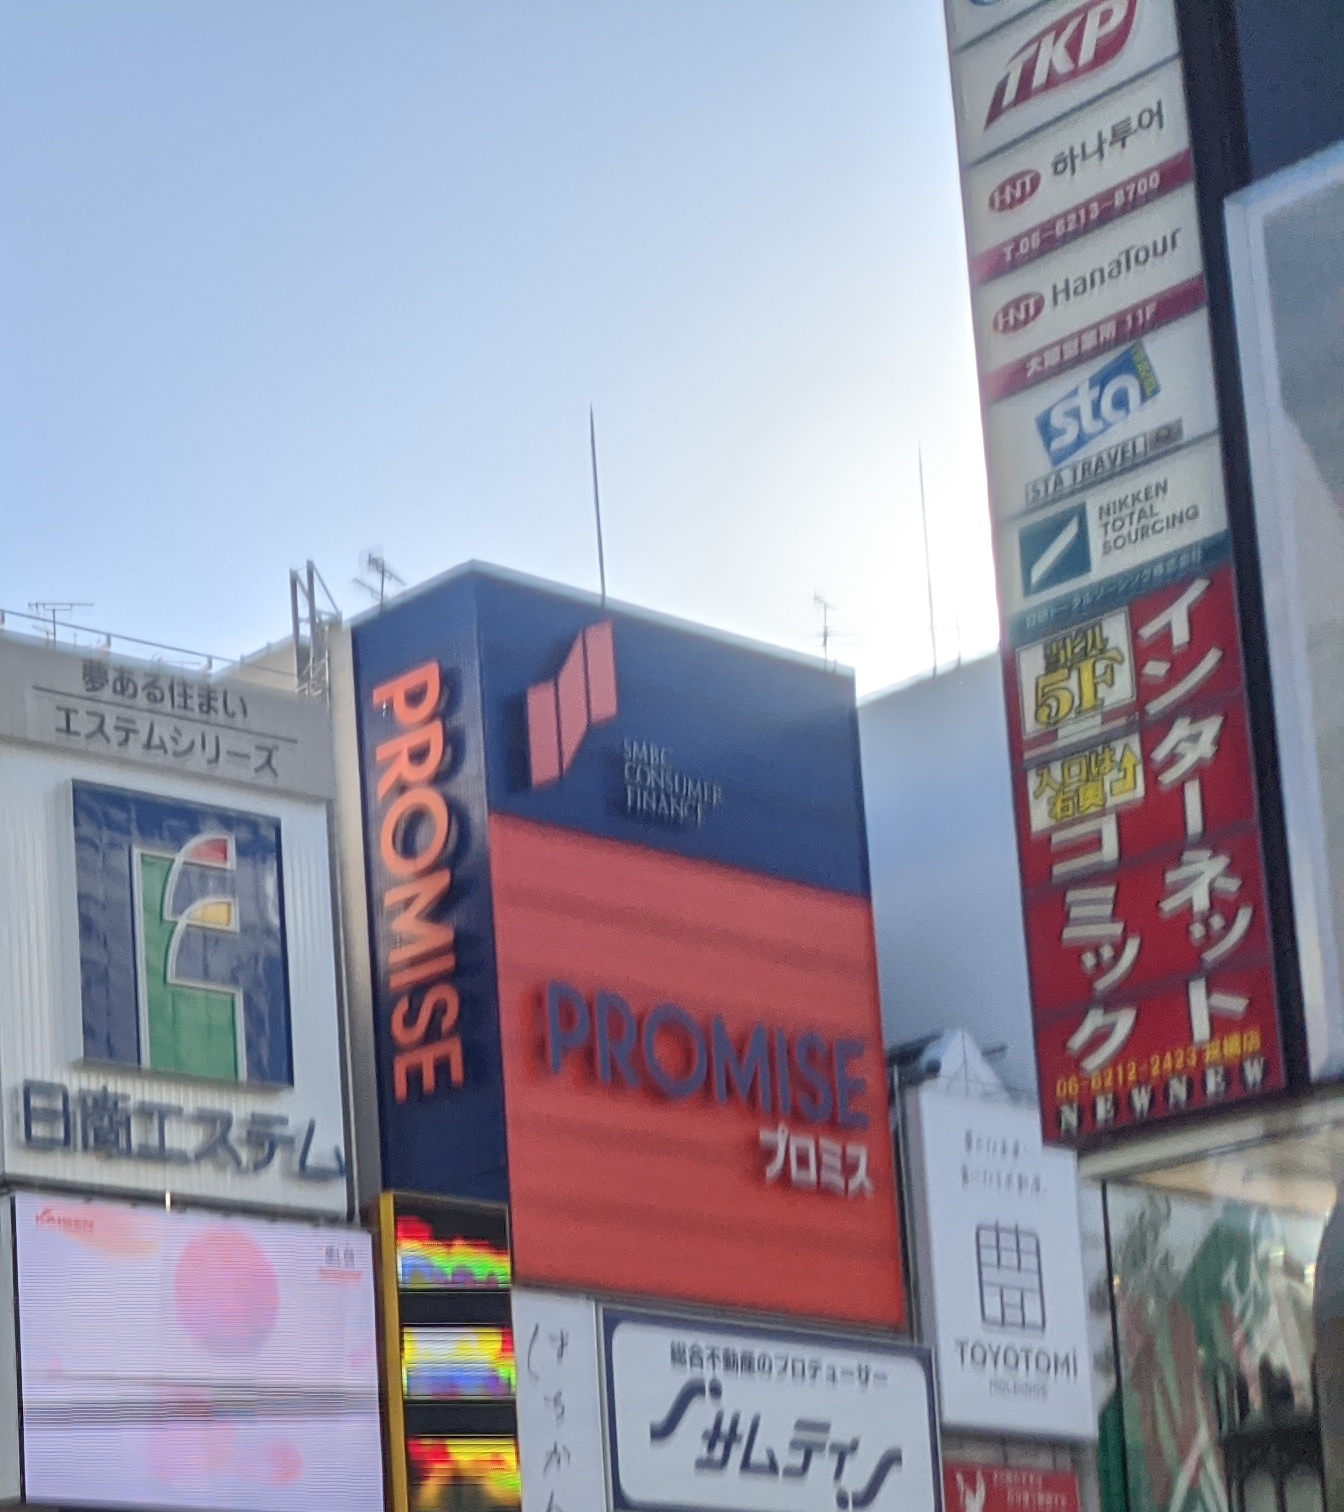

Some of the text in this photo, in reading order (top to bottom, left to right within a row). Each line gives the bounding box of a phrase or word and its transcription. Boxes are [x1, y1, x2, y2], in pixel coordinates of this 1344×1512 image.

[1002, 0, 1129, 109] TKP
[1052, 97, 1164, 177] 하나투어
[1052, 228, 1182, 307] HanaTour
[1030, 437, 1141, 501] STA TRAVEL
[1098, 478, 1169, 522] NIKKEN
[1101, 503, 1160, 538] TOTAL
[1101, 503, 1200, 557] SOURCING
[80, 658, 249, 721] 夢ある住まい
[1035, 647, 1125, 728] 5F
[54, 705, 280, 779] エステムシリーズ
[1033, 743, 1116, 799] 入口は
[1138, 578, 1254, 1046] インターネット
[373, 658, 465, 1102] PROMISE
[1050, 810, 1142, 1075] コミック
[545, 980, 871, 1130] PROMISE
[758, 1124, 874, 1198] プロミス
[955, 1339, 1079, 1382] TOYOTOMI
